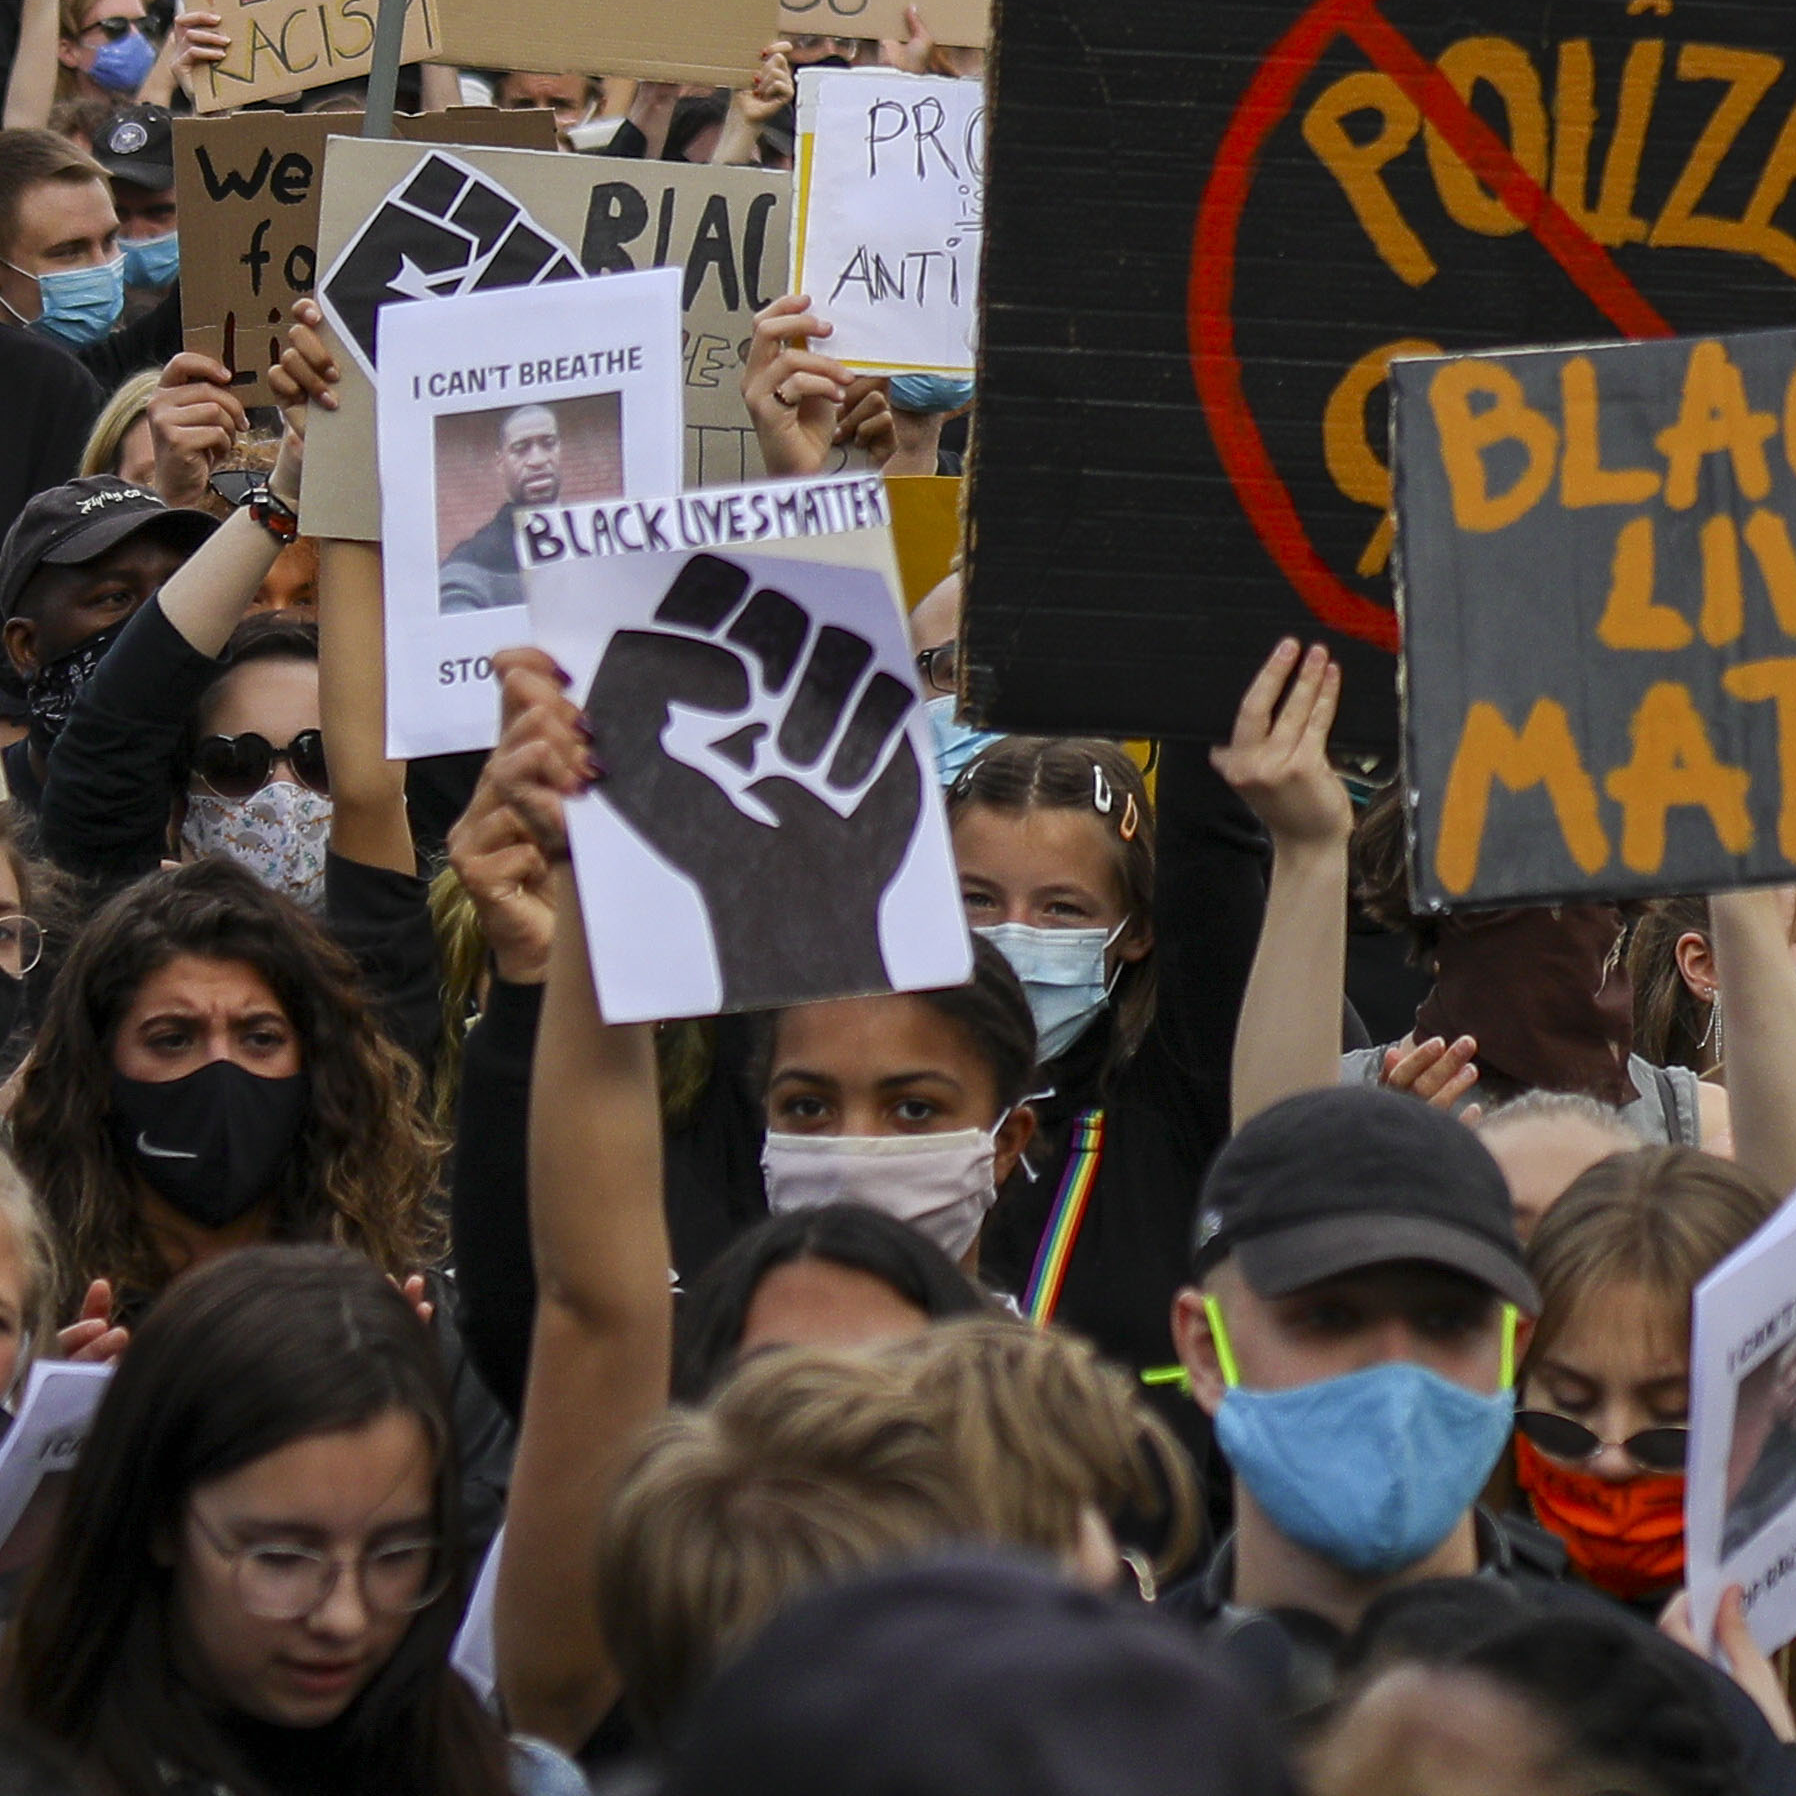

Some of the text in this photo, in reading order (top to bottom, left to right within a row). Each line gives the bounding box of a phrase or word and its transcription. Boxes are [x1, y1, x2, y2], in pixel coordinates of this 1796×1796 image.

[194, 144, 315, 204] We
[411, 375, 421, 400] I
[427, 362, 514, 398] CAN'T
[518, 345, 644, 387] BREATHE
[523, 480, 886, 565] BLACK LIVES MATTER
